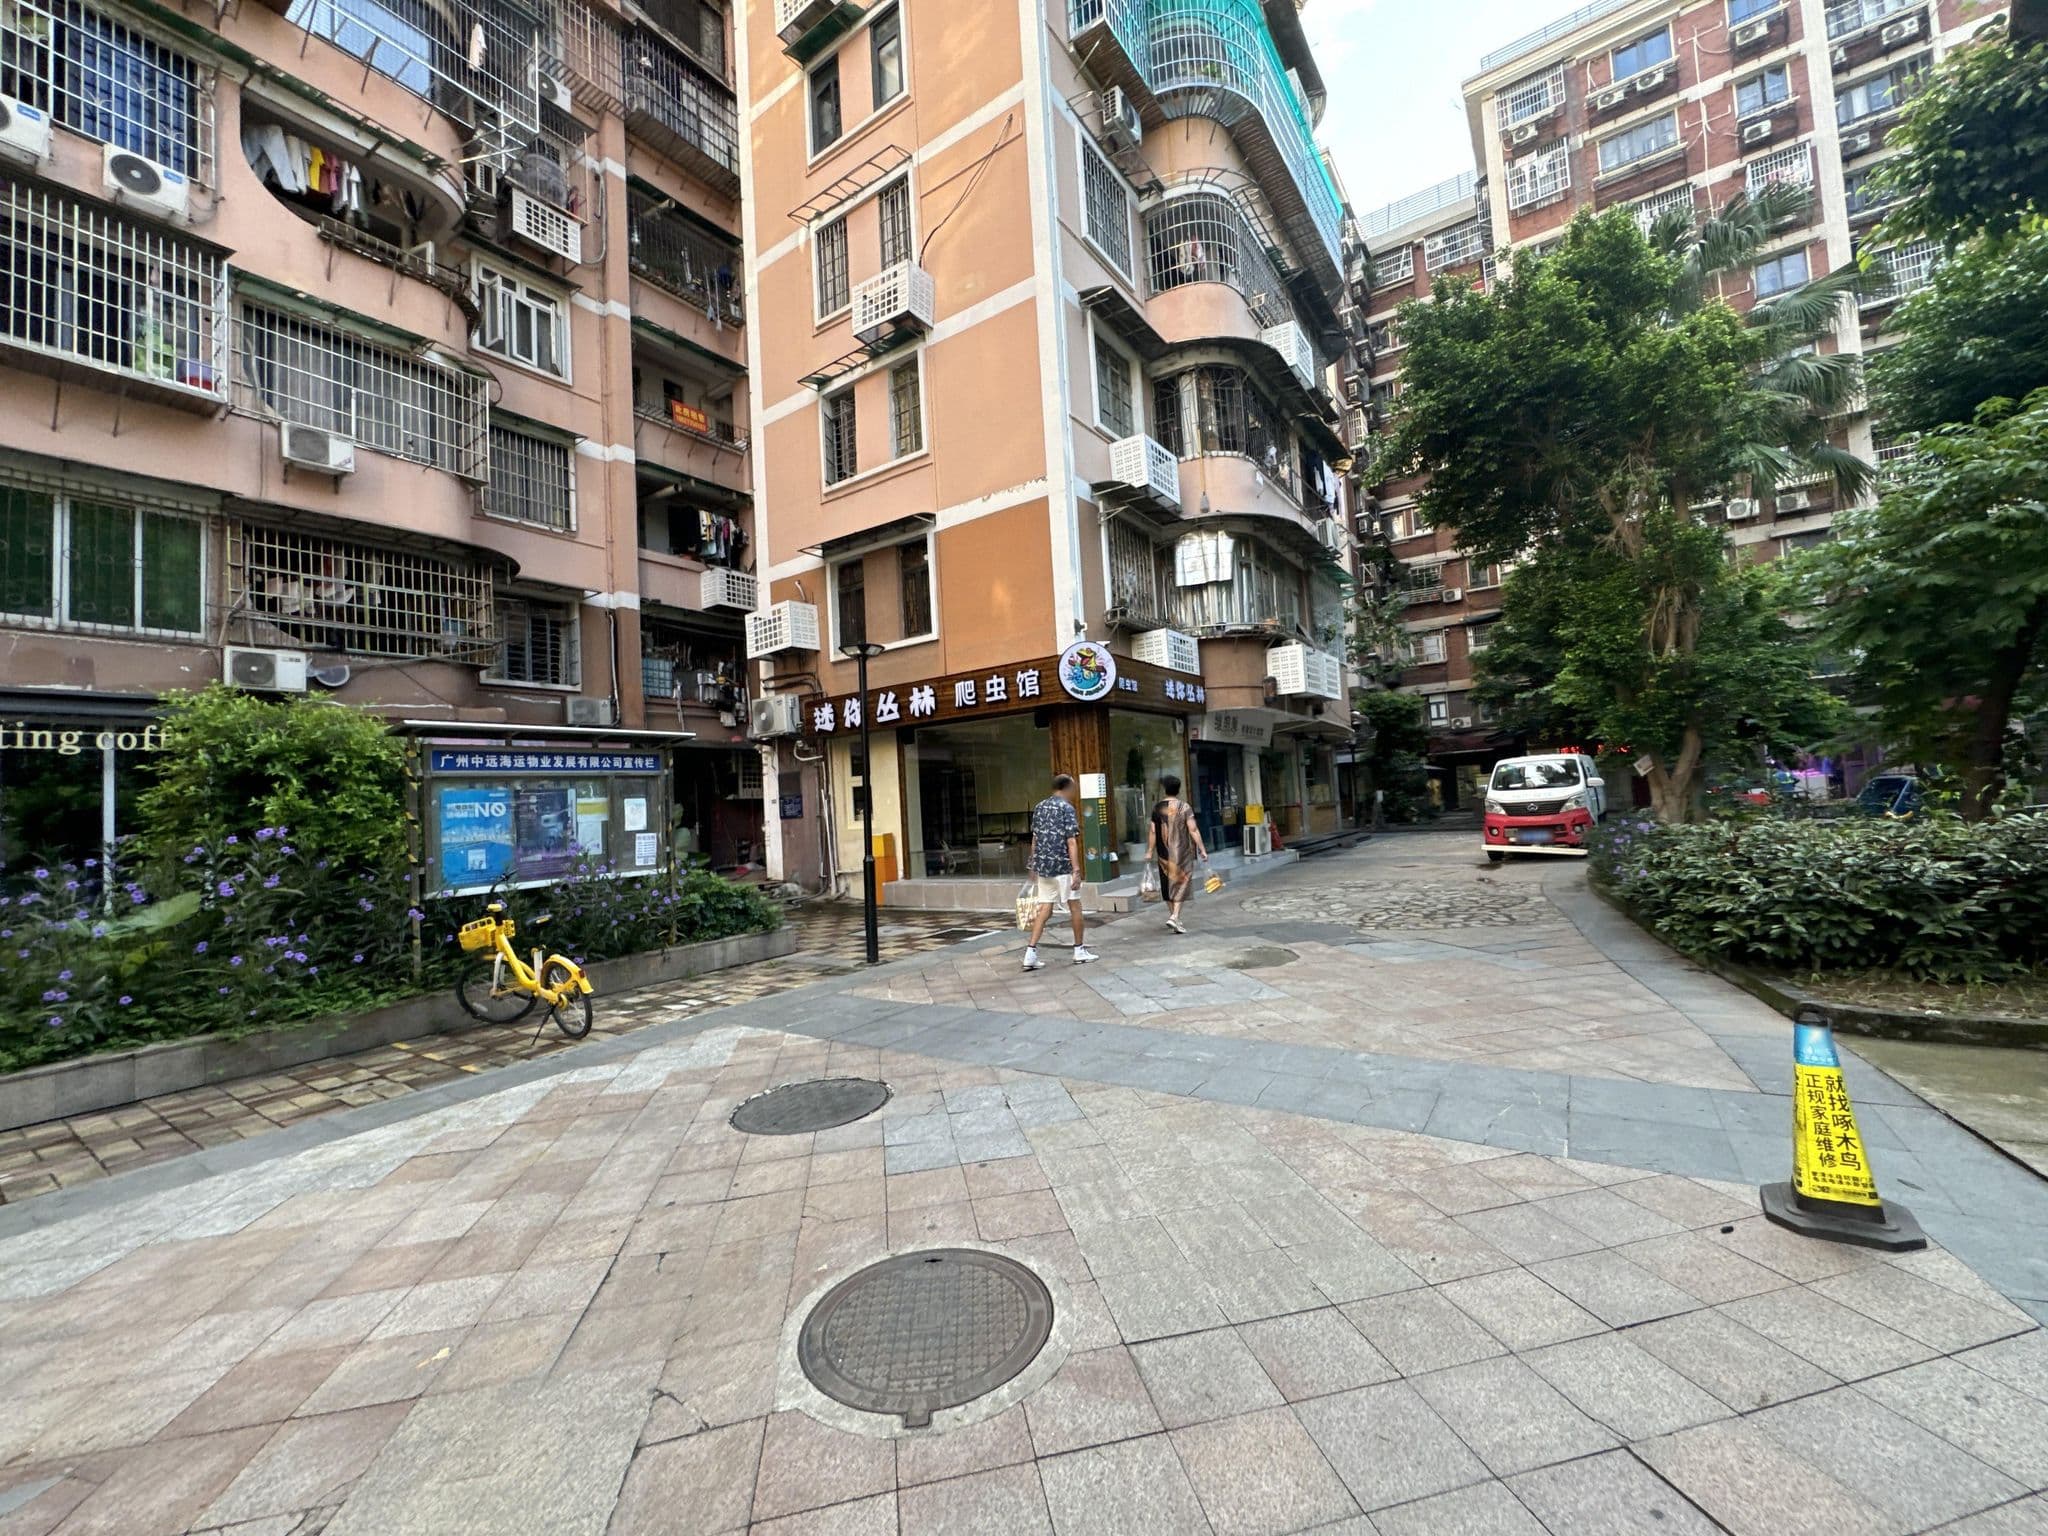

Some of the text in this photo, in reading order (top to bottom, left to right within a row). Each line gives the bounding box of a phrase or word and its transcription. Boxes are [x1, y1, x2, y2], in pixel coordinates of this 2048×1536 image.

[813, 668, 1040, 733] 迷你丛林 爬虫馆
[439, 754, 656, 769] 广州中远海运物业发展有限公司宣传栏
[474, 801, 507, 818] NO
[1805, 1073, 1838, 1169] 正规家庭维修
[1824, 1074, 1862, 1172] 就找啄木鸟
